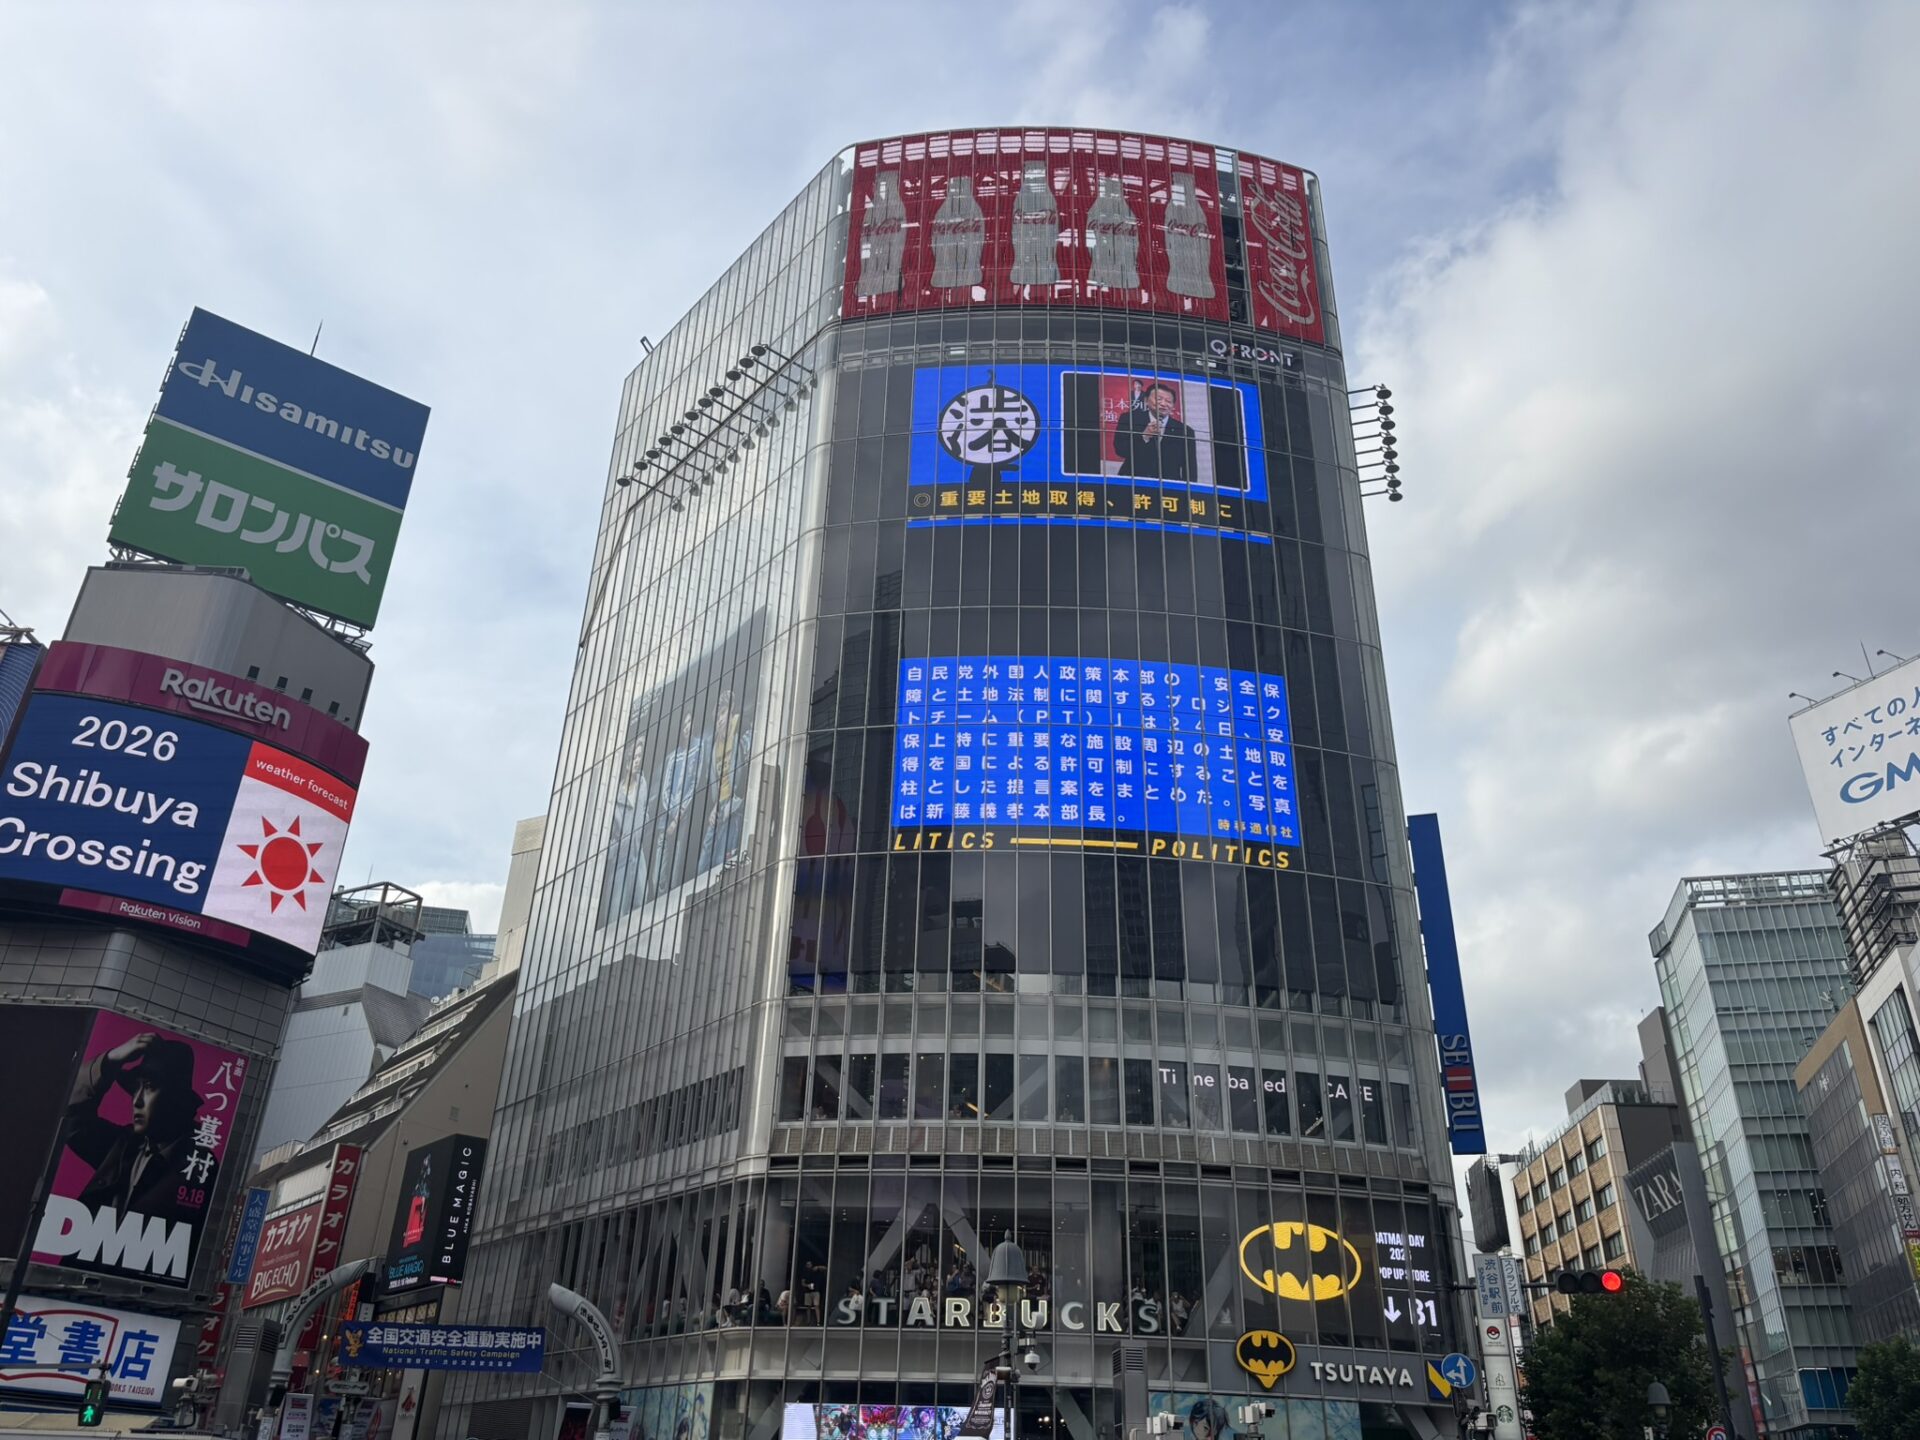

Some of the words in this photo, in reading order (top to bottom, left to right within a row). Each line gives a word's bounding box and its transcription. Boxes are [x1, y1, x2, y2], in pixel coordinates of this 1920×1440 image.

[1210, 339, 1294, 367] QFRONT
[177, 358, 414, 469] Hisamitsu
[149, 460, 376, 585] サロンパス
[160, 667, 291, 731] Rakuten
[907, 665, 1281, 699] 自民党外国人政策本部の安全保
[72, 715, 179, 761] 2026
[6, 761, 200, 828] Shibuya
[256, 758, 306, 787] weather
[307, 779, 349, 811] forecast
[0, 817, 206, 895] Crossing
[1151, 838, 1290, 869] POLITICS
[120, 901, 166, 921] Rakuten
[169, 912, 201, 929] Vision
[1227, 1073, 1286, 1093] baed
[1327, 1082, 1374, 1102] CAE
[1441, 1033, 1481, 1132] SEIBU
[180, 1061, 236, 1184] 八つ墓村
[176, 1186, 205, 1205] 9.18
[317, 1158, 355, 1254] カラオケ
[441, 1215, 460, 1264] BLUE
[452, 1147, 472, 1208] MAGIC
[1634, 1169, 1683, 1221] ZARA
[33, 1193, 192, 1279] DMM
[262, 1211, 312, 1253] カラオケ
[1375, 1231, 1404, 1246] BATMA
[1408, 1234, 1425, 1248] DAY
[1389, 1247, 1412, 1261] 202
[1393, 1267, 1404, 1280] UP
[1484, 1258, 1503, 1314] 渋谷駅前
[1504, 1259, 1521, 1312] スクランブル式
[197, 1292, 225, 1354] ラオケ
[366, 1326, 541, 1349] 全国交通安全運動実施中
[837, 1297, 1160, 1334] STARBUCKS
[382, 1346, 417, 1356] National
[420, 1347, 447, 1357] Traffic
[450, 1348, 478, 1359] Safety
[480, 1350, 521, 1360] Campaign
[1310, 1362, 1414, 1387] TSUTAYA
